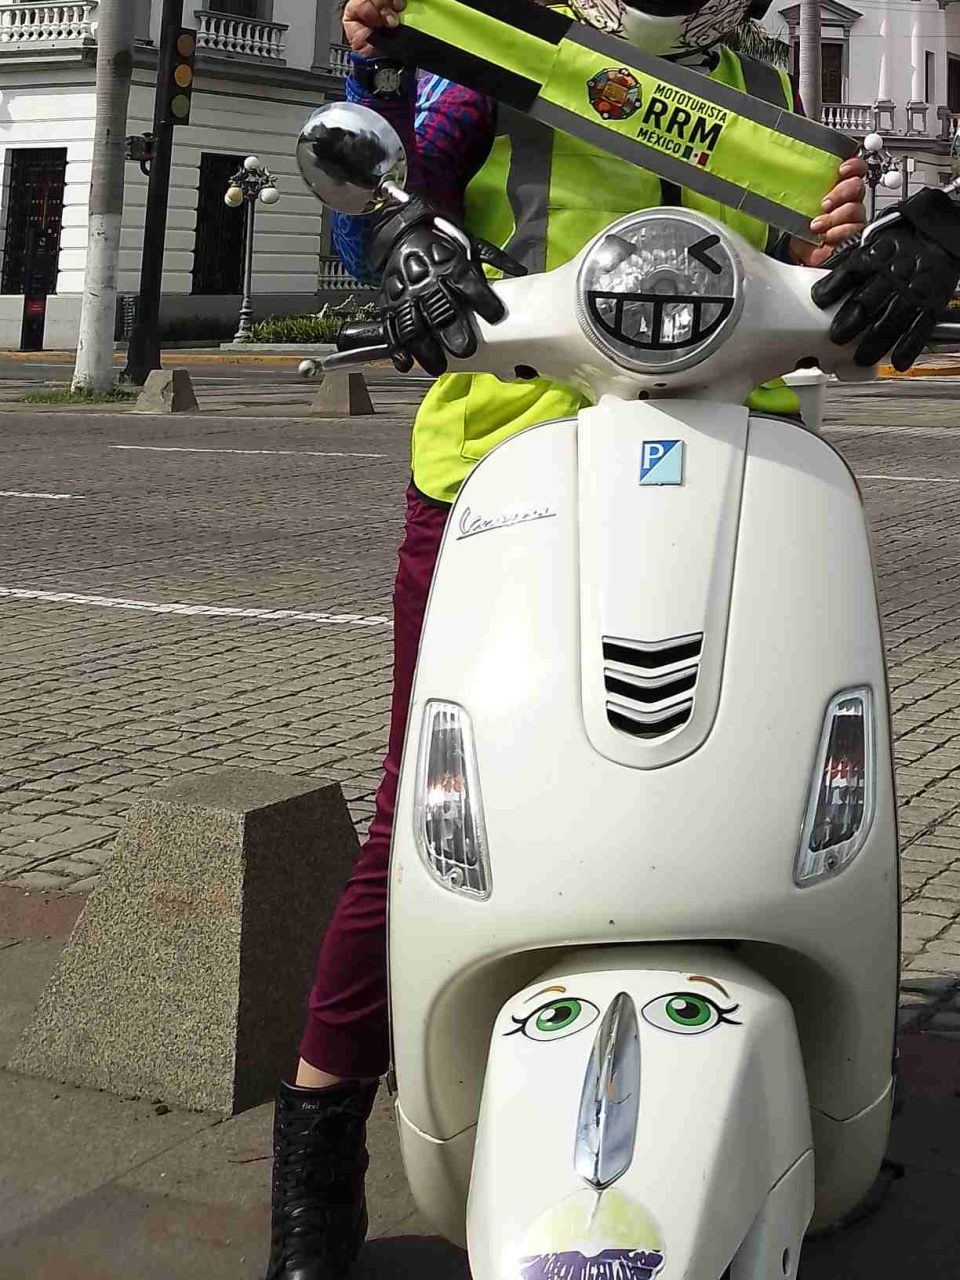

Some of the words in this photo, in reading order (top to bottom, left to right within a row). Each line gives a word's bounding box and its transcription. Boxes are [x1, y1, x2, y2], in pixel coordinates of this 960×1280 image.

[653, 83, 728, 123] MOTOTURISTA
[636, 127, 682, 154] MÉXICO
[642, 96, 723, 152] RRM
[643, 443, 665, 469] P
